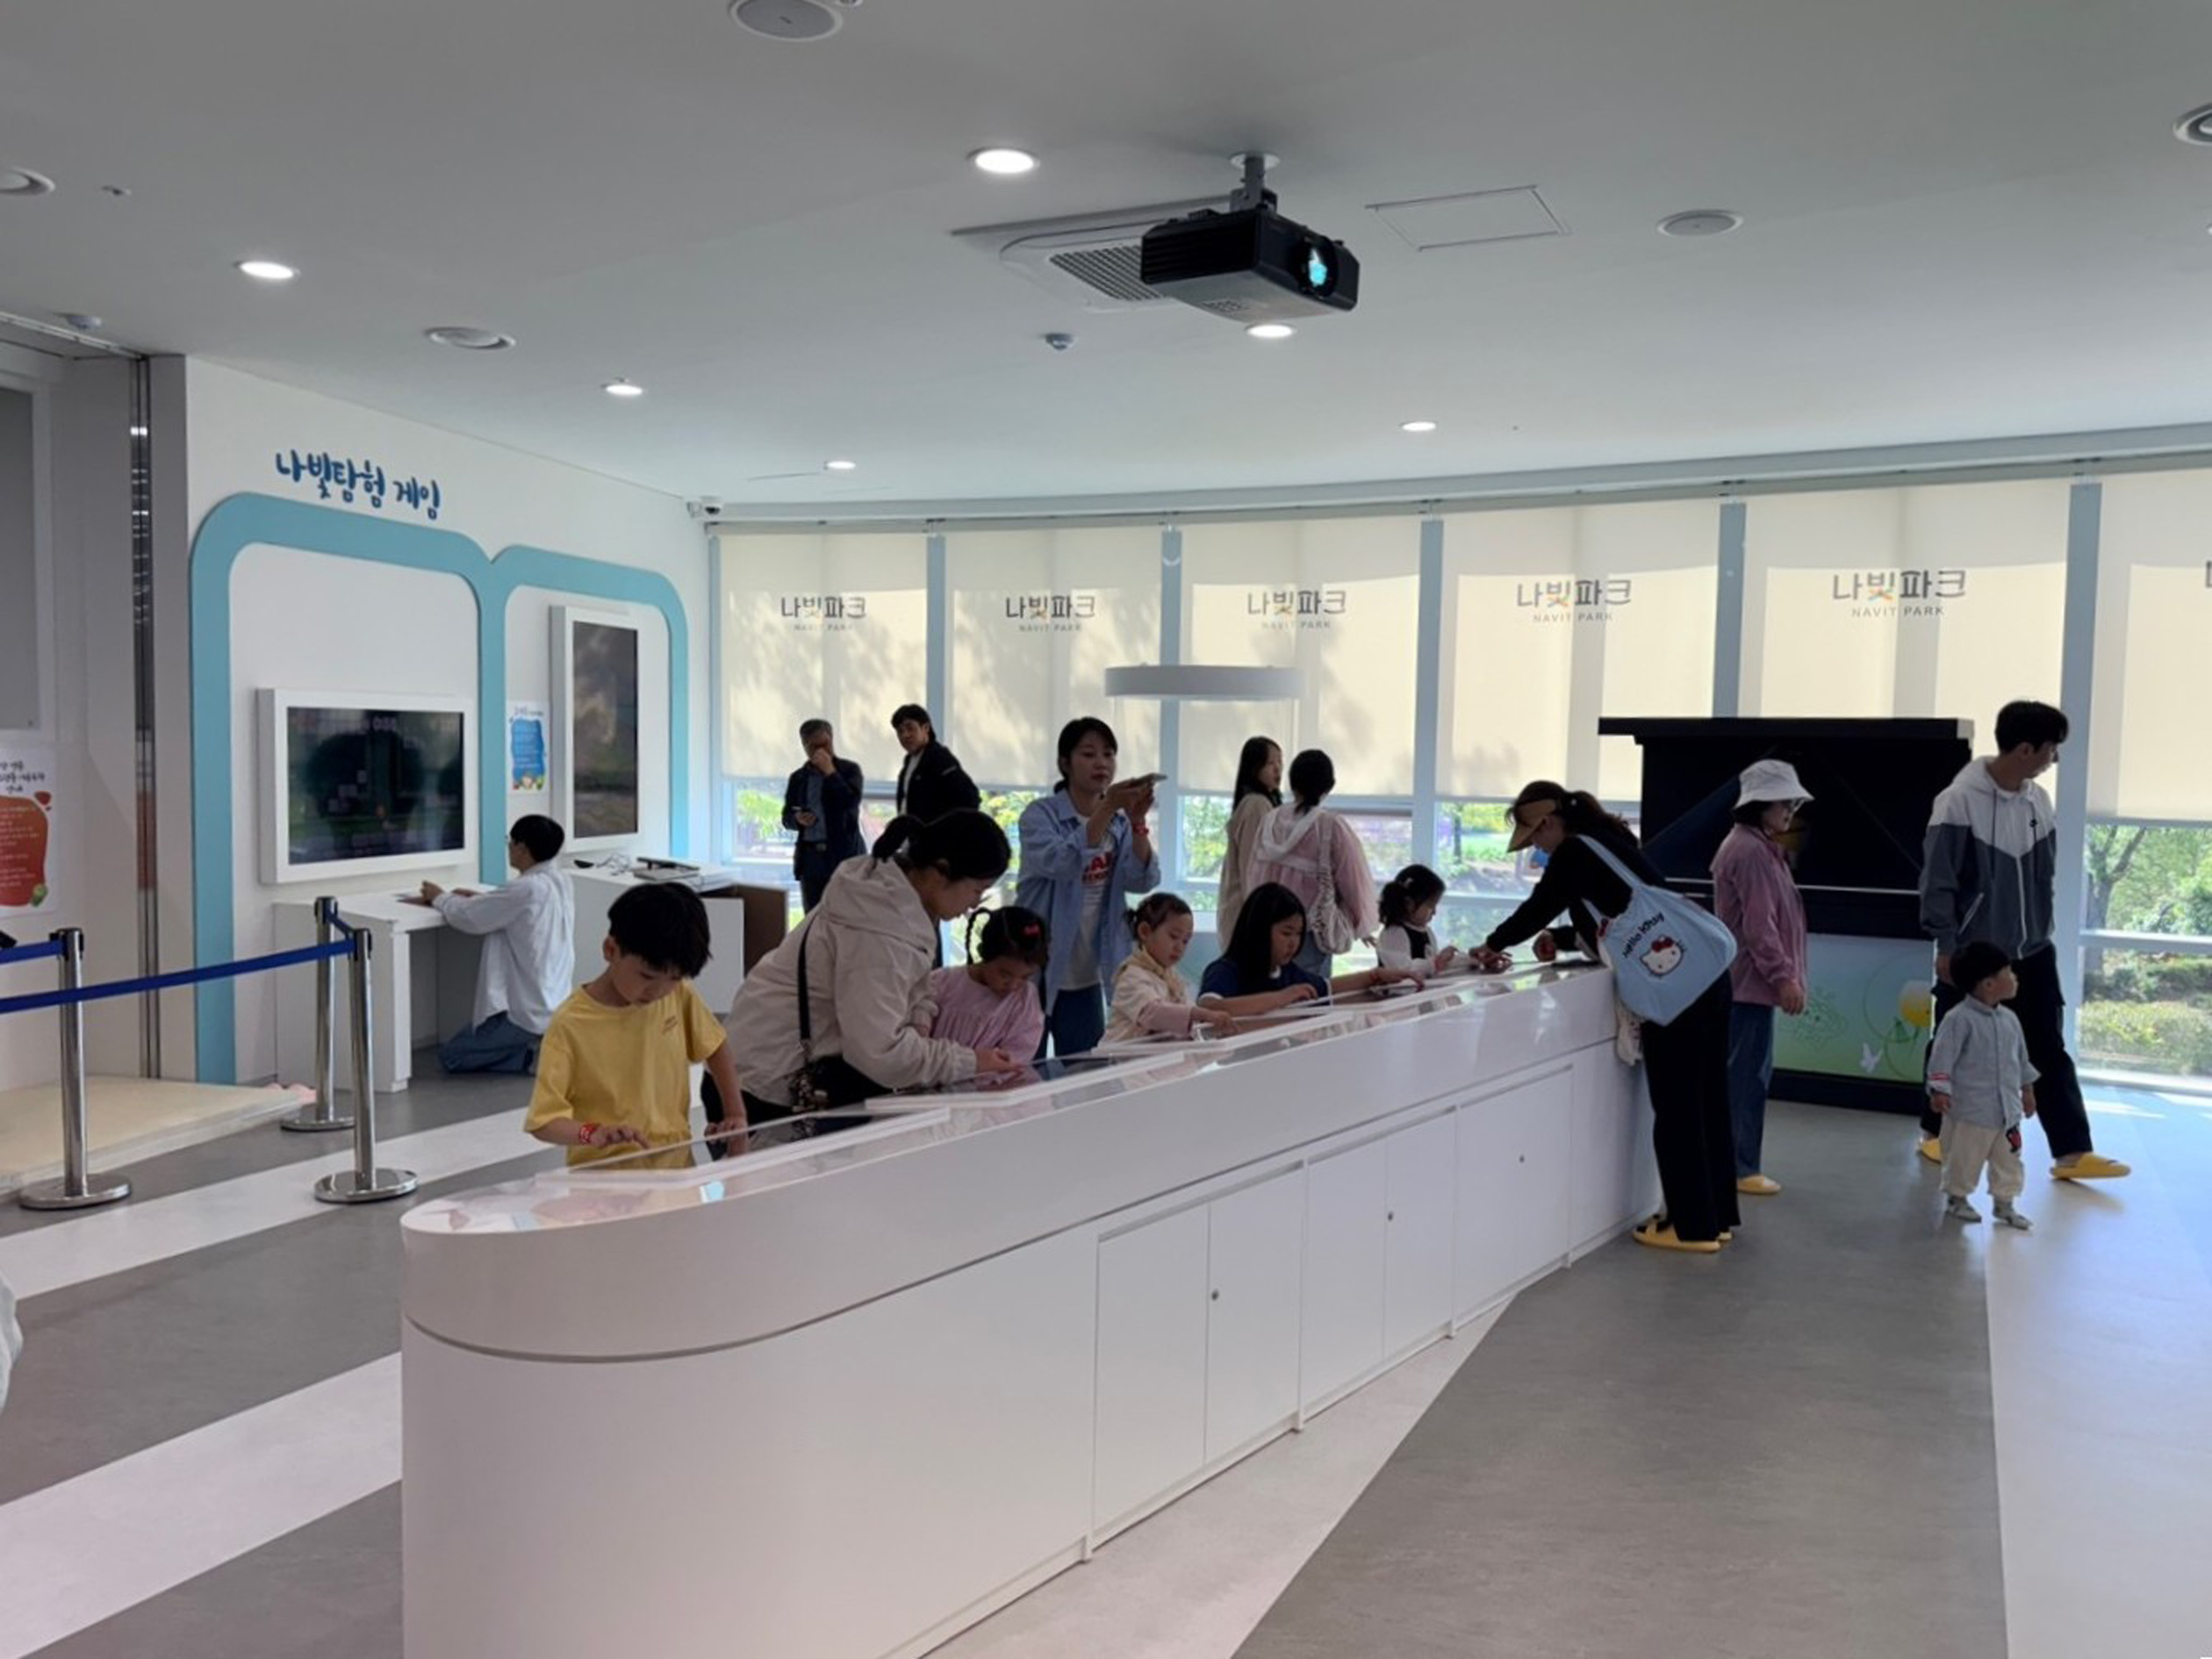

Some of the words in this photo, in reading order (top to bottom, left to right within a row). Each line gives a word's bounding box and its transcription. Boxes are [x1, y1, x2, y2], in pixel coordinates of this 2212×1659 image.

[393, 477, 440, 520] 게임
[1517, 578, 1632, 608] 나빛파크
[1832, 569, 1966, 601] 나빛파크
[1005, 594, 1096, 619] 나빛파크
[1247, 590, 1347, 615] 나빛파크
[1851, 606, 1896, 618] NAVIT
[1903, 605, 1944, 617] PARK
[1577, 612, 1613, 621] PARK
